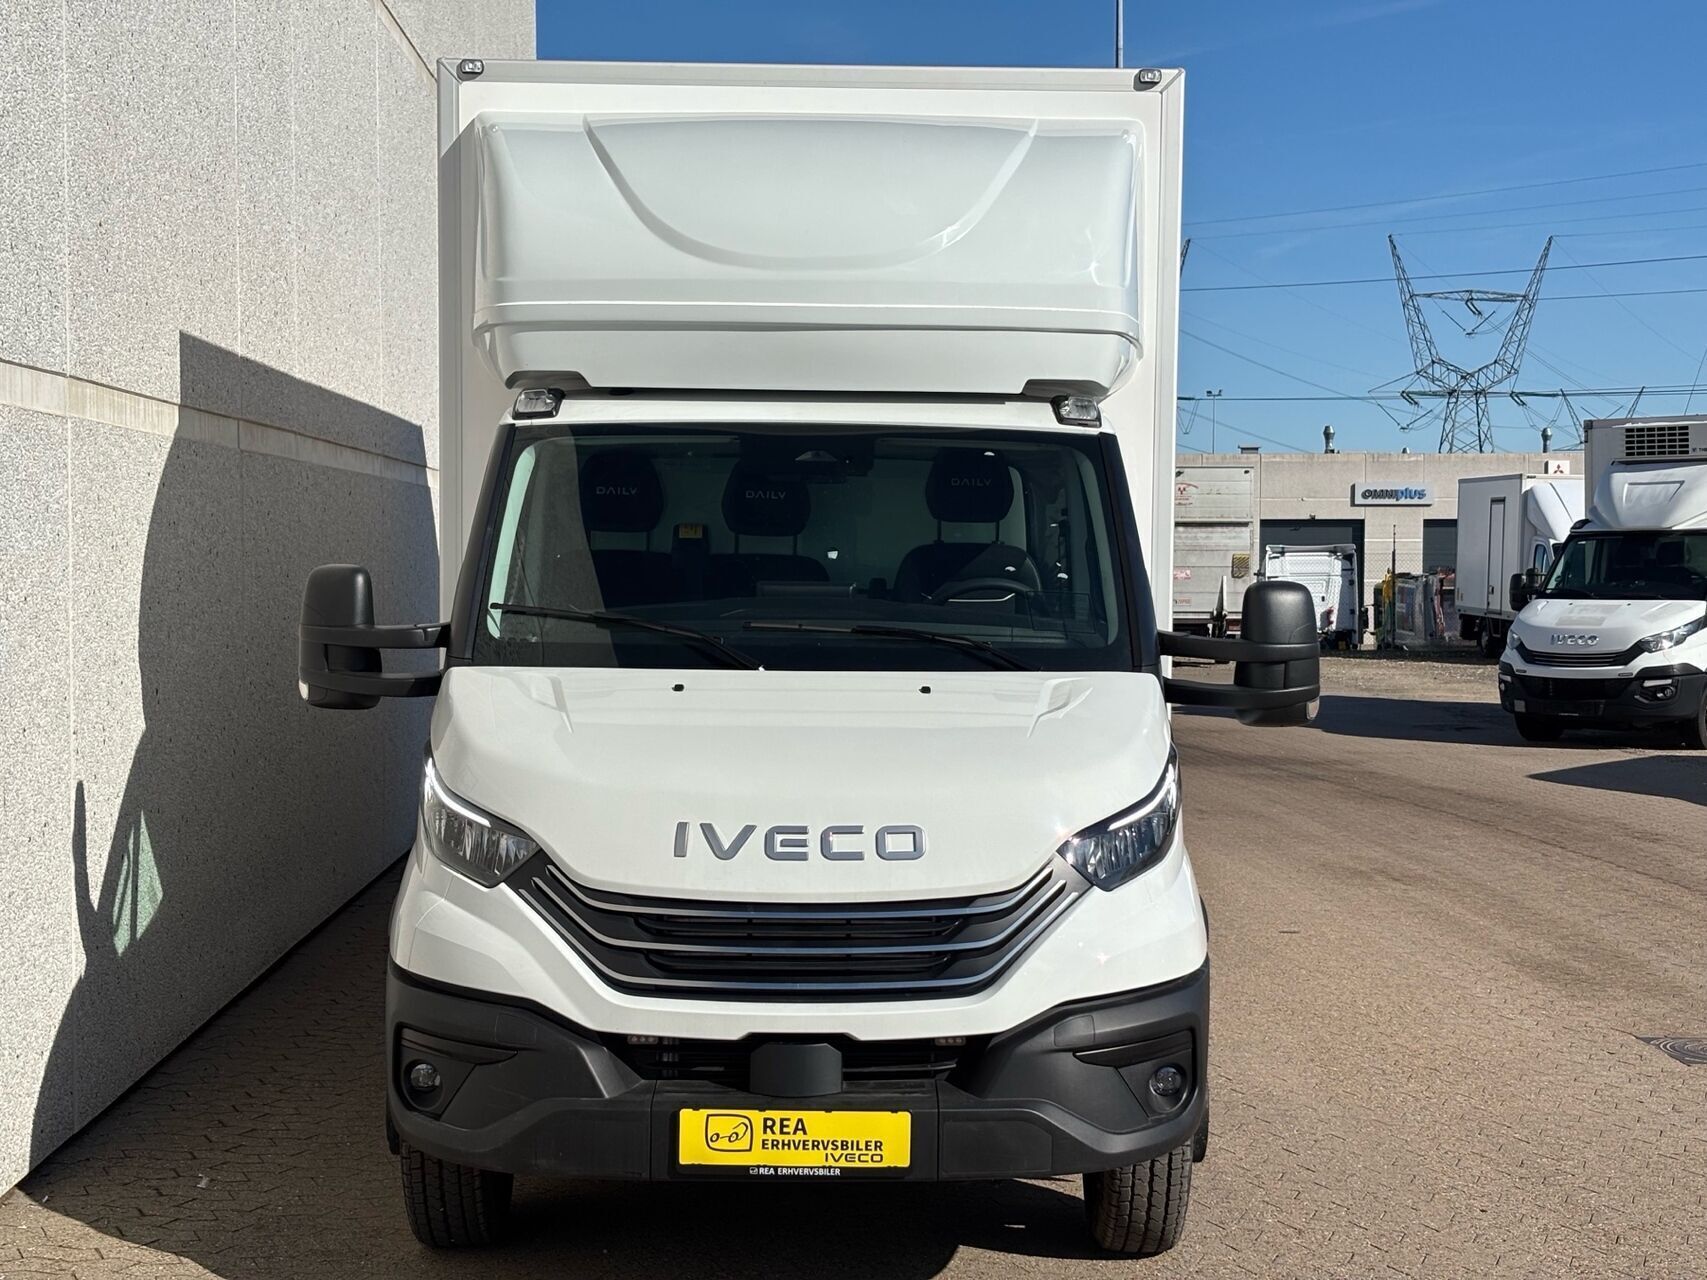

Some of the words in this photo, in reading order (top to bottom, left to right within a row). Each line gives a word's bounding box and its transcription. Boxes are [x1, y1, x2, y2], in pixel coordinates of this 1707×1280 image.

[951, 478, 992, 487] DAILY
[595, 486, 638, 496] DAILY
[745, 490, 787, 499] DAILY
[1550, 634, 1600, 646] IVECO
[673, 821, 927, 861] IVECO
[762, 1117, 808, 1136] REA
[761, 1138, 884, 1152] ERHVERVSBILER
[825, 1152, 884, 1163] IVECO
[759, 1167, 775, 1176] REA
[777, 1167, 841, 1176] ERHVERVSBILER
